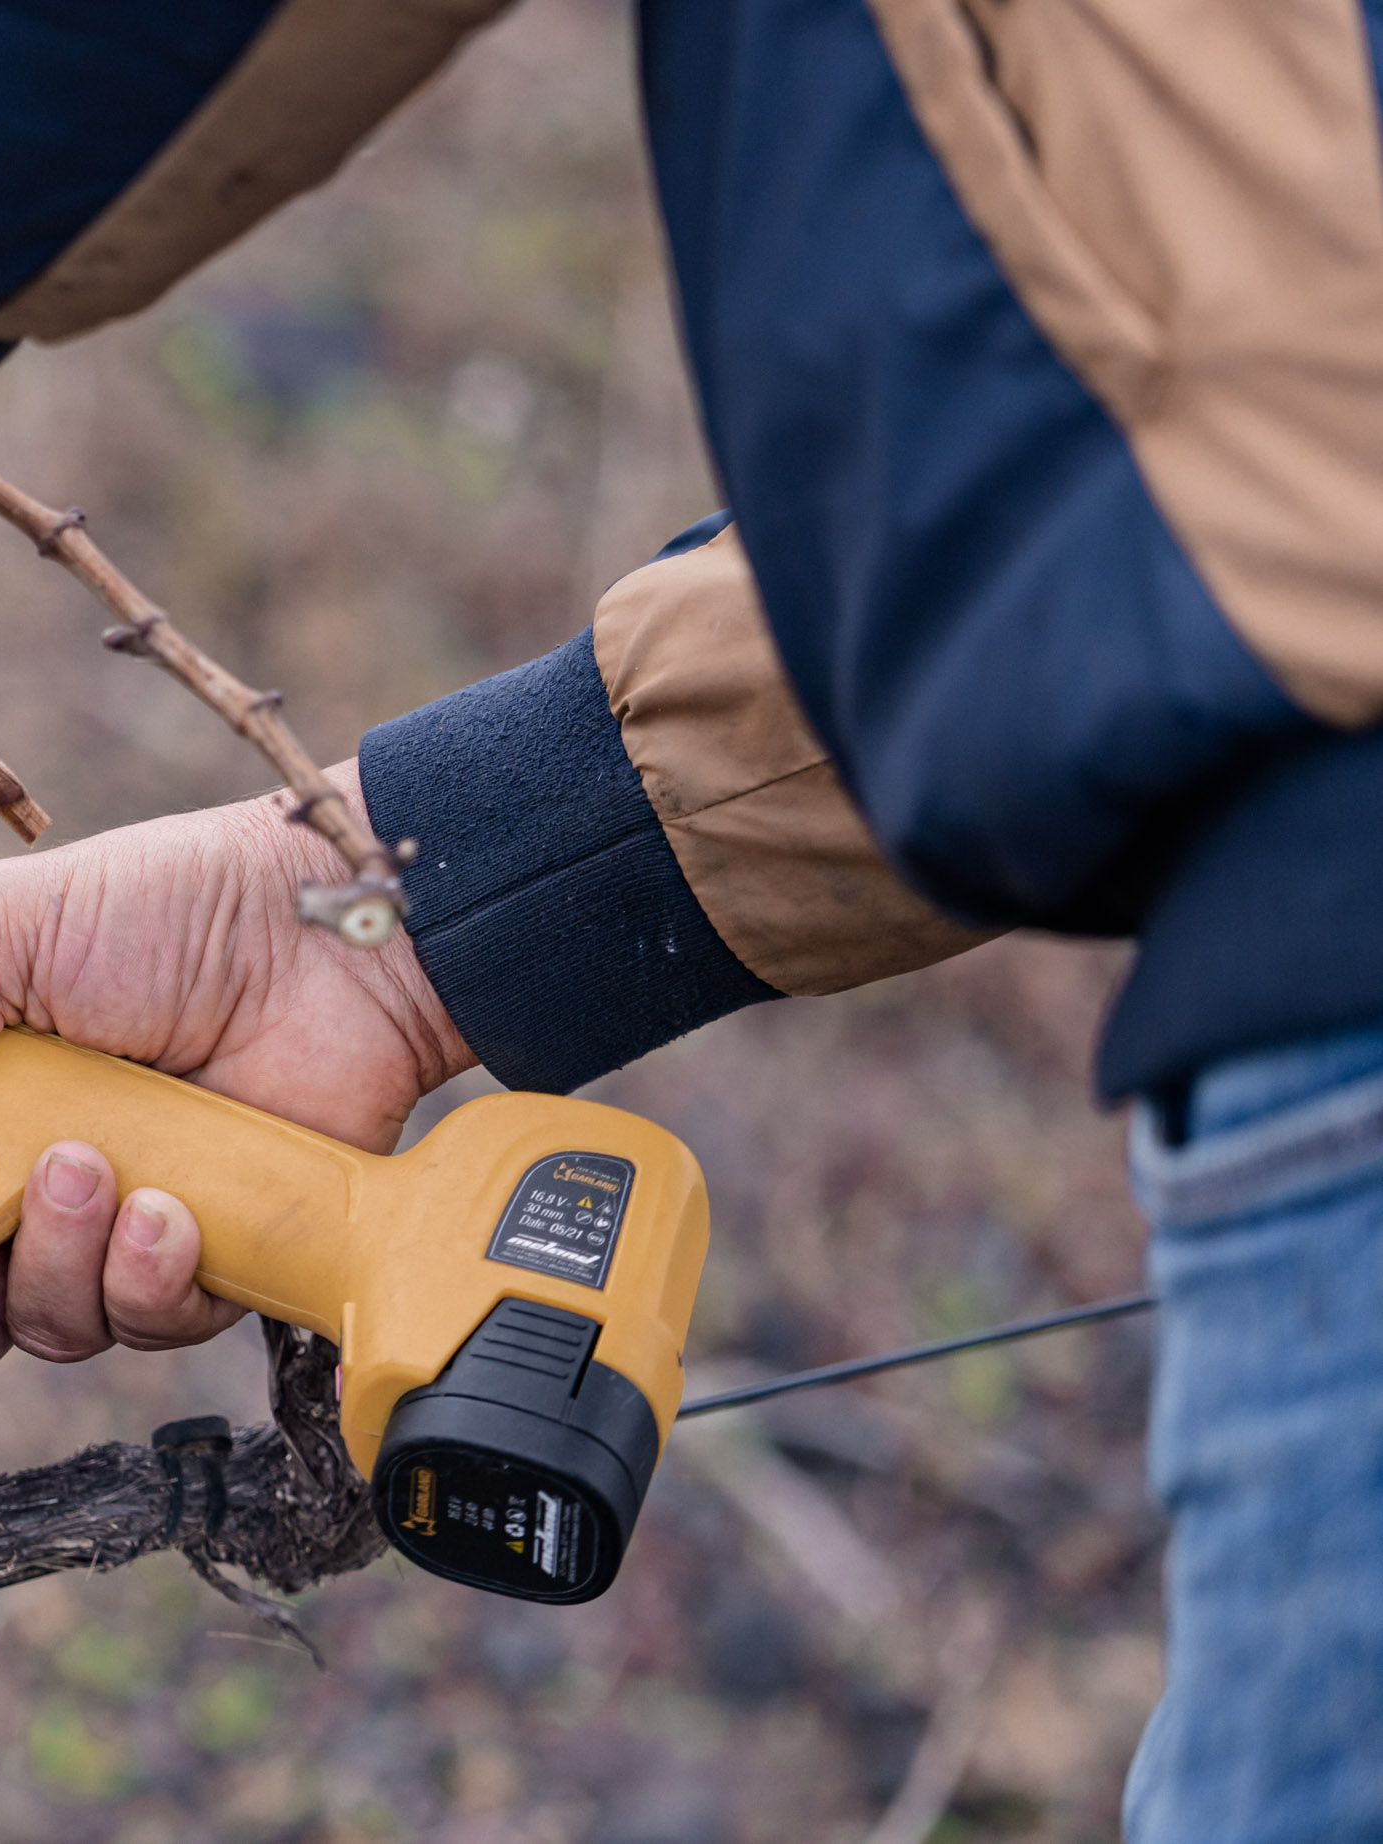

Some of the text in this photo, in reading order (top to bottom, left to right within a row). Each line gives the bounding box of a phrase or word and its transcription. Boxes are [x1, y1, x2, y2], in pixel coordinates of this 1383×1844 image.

[570, 1171, 618, 1193] GARLAND
[529, 1189, 568, 1207] 16,8 V
[522, 1202, 565, 1221] 30 mm
[518, 1214, 546, 1230] Date:
[549, 1224, 584, 1240] 05/21
